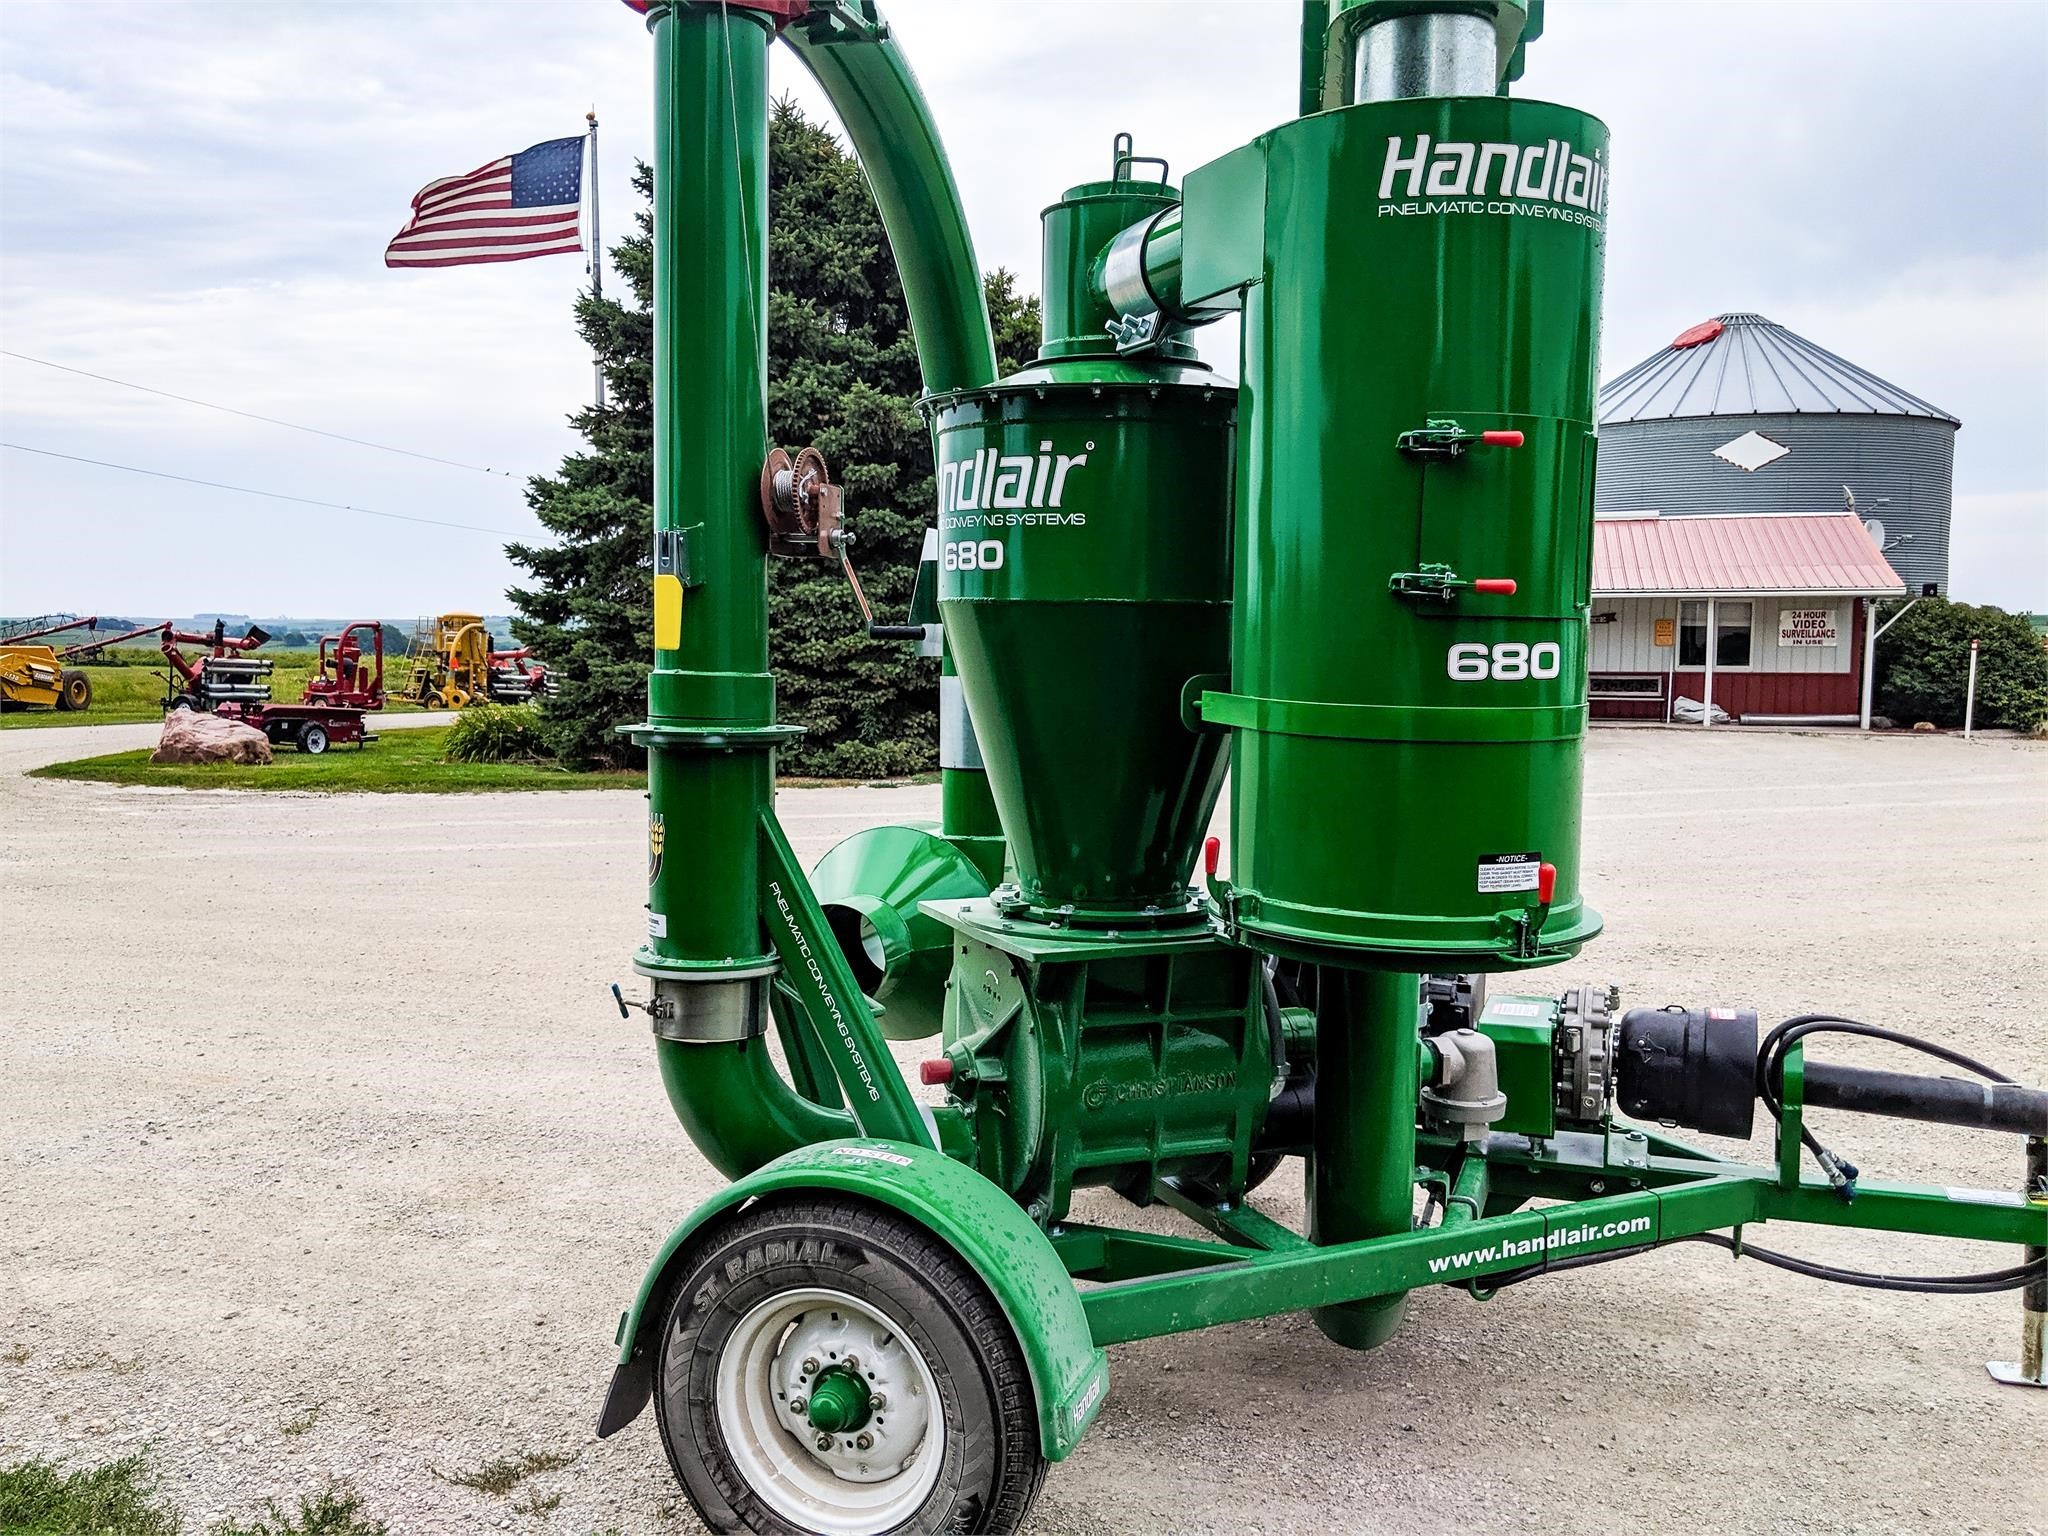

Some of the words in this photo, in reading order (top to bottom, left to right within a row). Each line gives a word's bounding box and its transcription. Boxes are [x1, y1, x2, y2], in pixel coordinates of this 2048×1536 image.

[1378, 134, 1605, 215] Handlair
[1378, 201, 1484, 217] PNEUMATIC
[1487, 203, 1573, 222] CONVEYING
[1574, 211, 1602, 232] SYSTE
[940, 440, 1088, 513] ndlair
[1006, 513, 1086, 526] SYSTEMS
[945, 540, 1004, 571] 680
[1792, 611, 1801, 619] 24
[1803, 611, 1827, 619] HOUR
[1792, 619, 1826, 629] VIDEO
[1781, 629, 1836, 639] SURVEILLANCE
[1447, 642, 1561, 681] 680
[769, 882, 811, 958] PNEUMATIC
[806, 958, 849, 1037] CONVEYING
[844, 1037, 880, 1101] SYSTEMS
[836, 1147, 863, 1155] NO
[868, 1151, 910, 1163] STEP
[1428, 1216, 1650, 1273] www.handlair.com
[693, 1274, 721, 1312] ST
[725, 1240, 838, 1283] RADIAL
